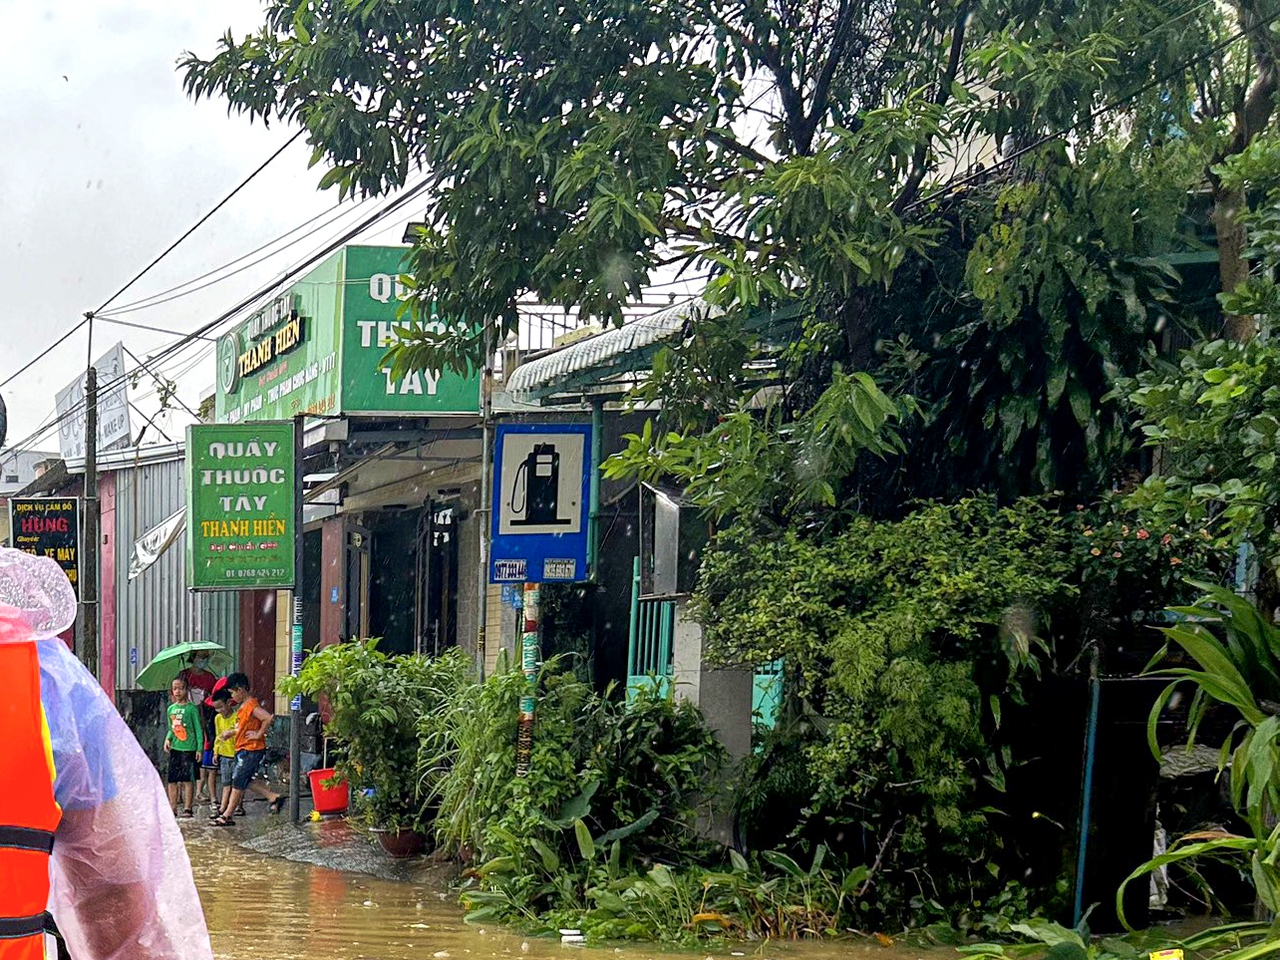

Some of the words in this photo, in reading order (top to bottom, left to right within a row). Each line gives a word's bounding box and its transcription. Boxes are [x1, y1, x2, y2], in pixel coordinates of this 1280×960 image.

[238, 337, 271, 378] THANH
[201, 463, 285, 485] THUỐC
[220, 493, 267, 511] TÂY
[201, 520, 249, 537] THANH
[271, 568, 285, 577] 212
